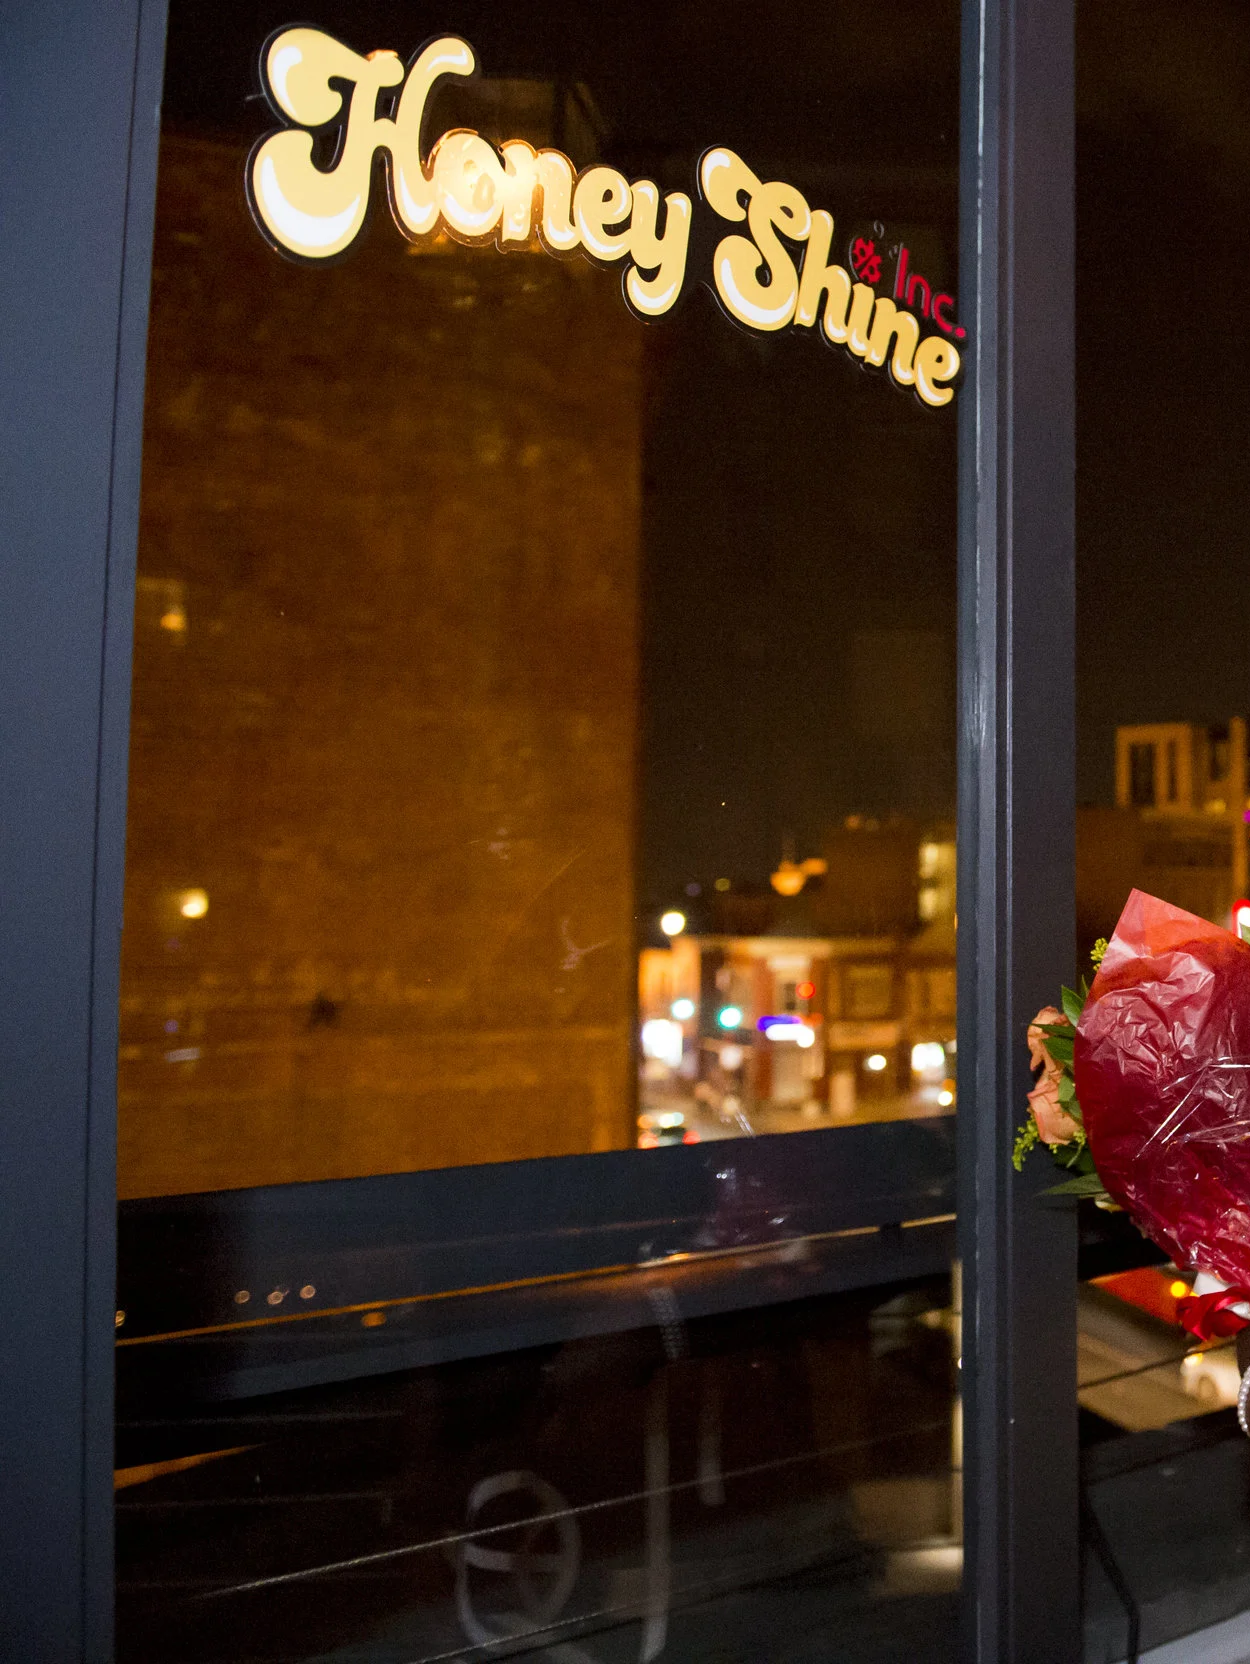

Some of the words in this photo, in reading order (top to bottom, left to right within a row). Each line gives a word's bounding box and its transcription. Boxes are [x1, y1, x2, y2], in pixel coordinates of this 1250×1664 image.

[253, 28, 691, 315] Honey
[702, 148, 960, 406] Shine
[896, 248, 966, 338] Inc.
